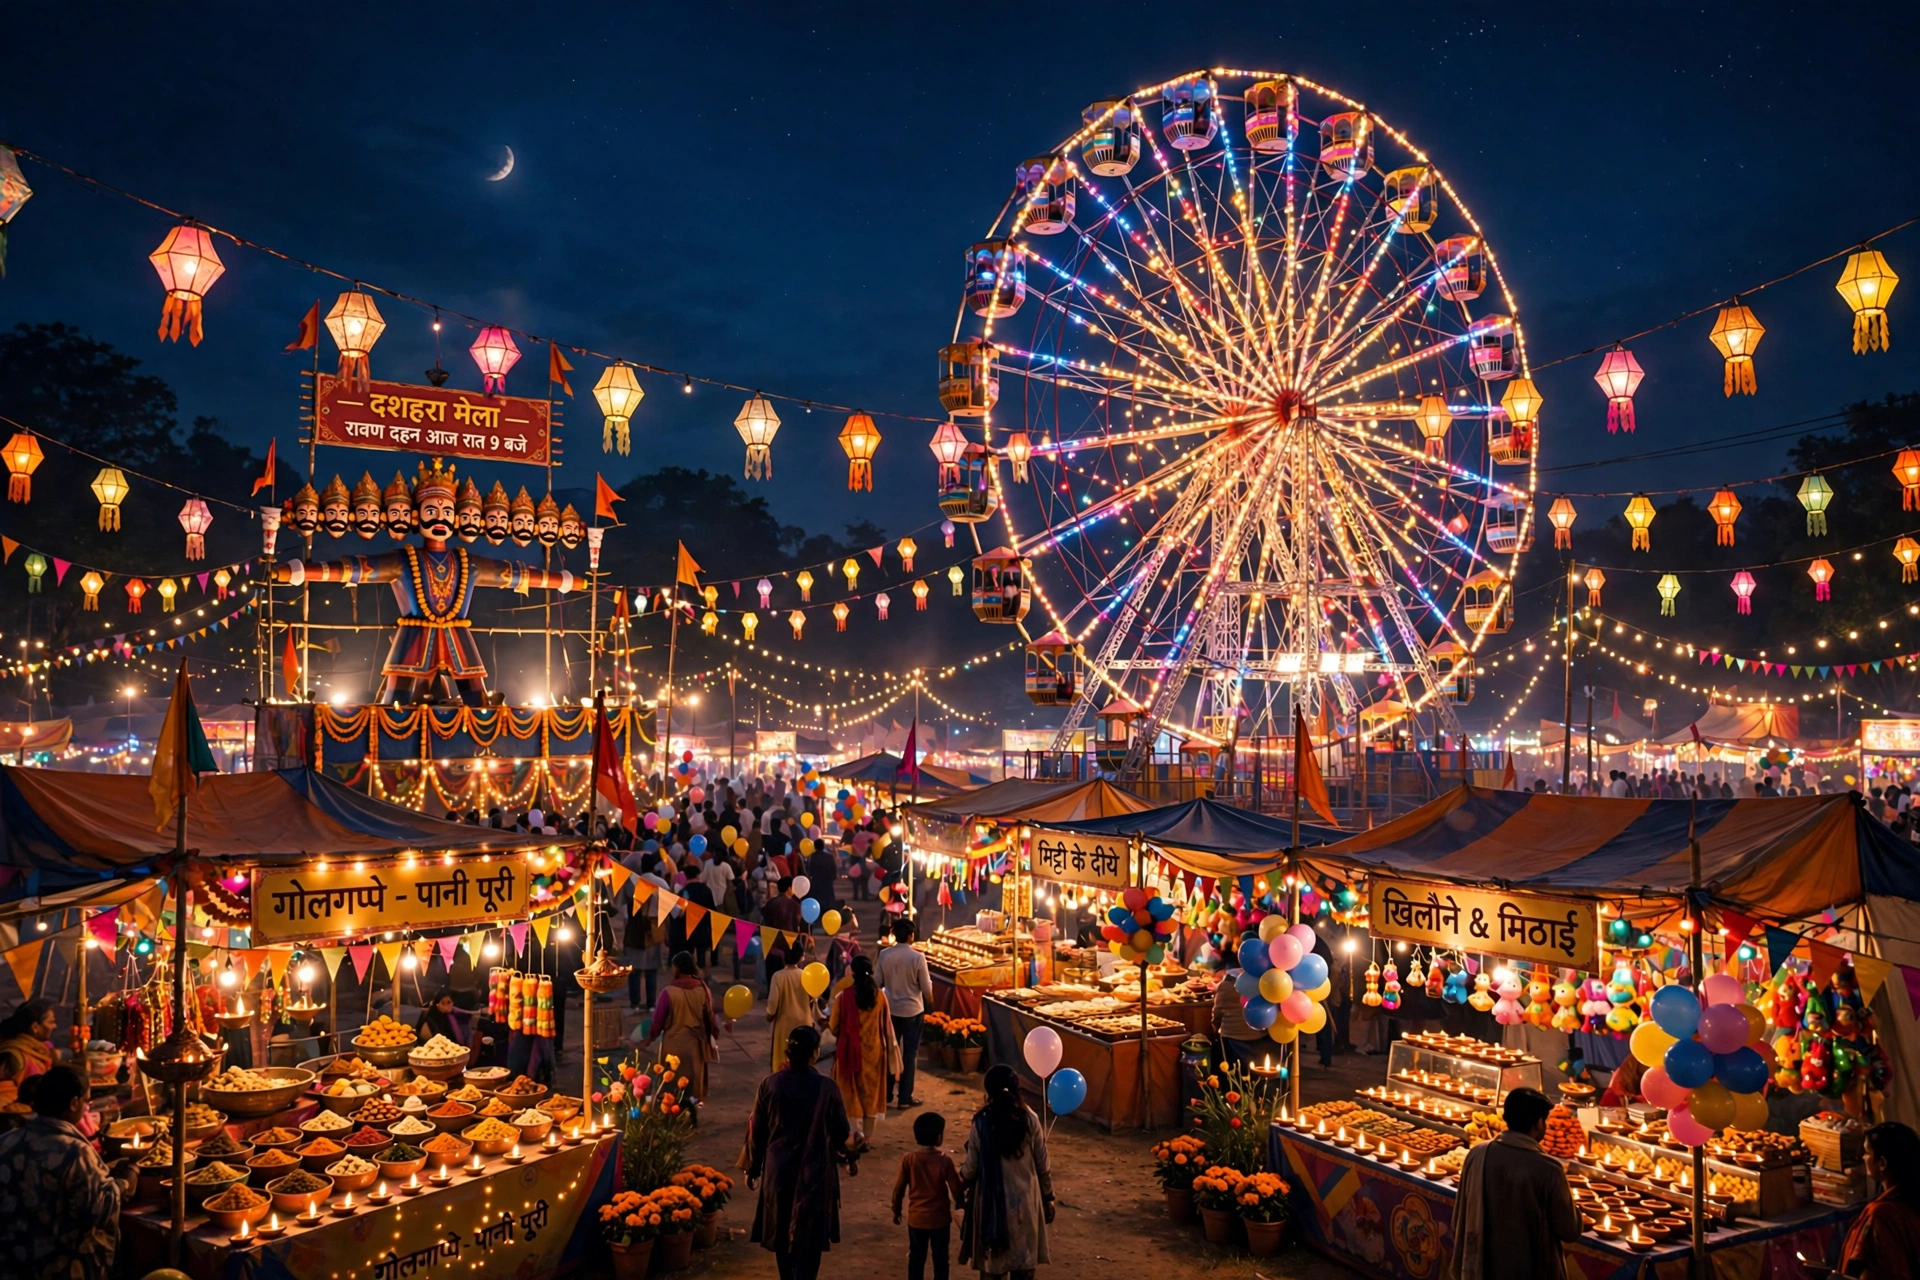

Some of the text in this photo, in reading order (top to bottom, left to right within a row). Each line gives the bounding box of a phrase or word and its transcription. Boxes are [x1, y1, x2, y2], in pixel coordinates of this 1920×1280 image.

[370, 393, 500, 428] दशहरा मेला
[345, 421, 527, 453] रावण दहन आज रात 9 बजे
[1038, 840, 1119, 877] मिट्टी के दीये
[272, 875, 387, 920] गोलगप्पे
[415, 869, 469, 908] पानी
[476, 866, 515, 913] पूरी
[1382, 887, 1579, 958] खिलौने & मिठाई
[475, 1212, 516, 1250] पानी
[520, 1199, 549, 1242] पूरी
